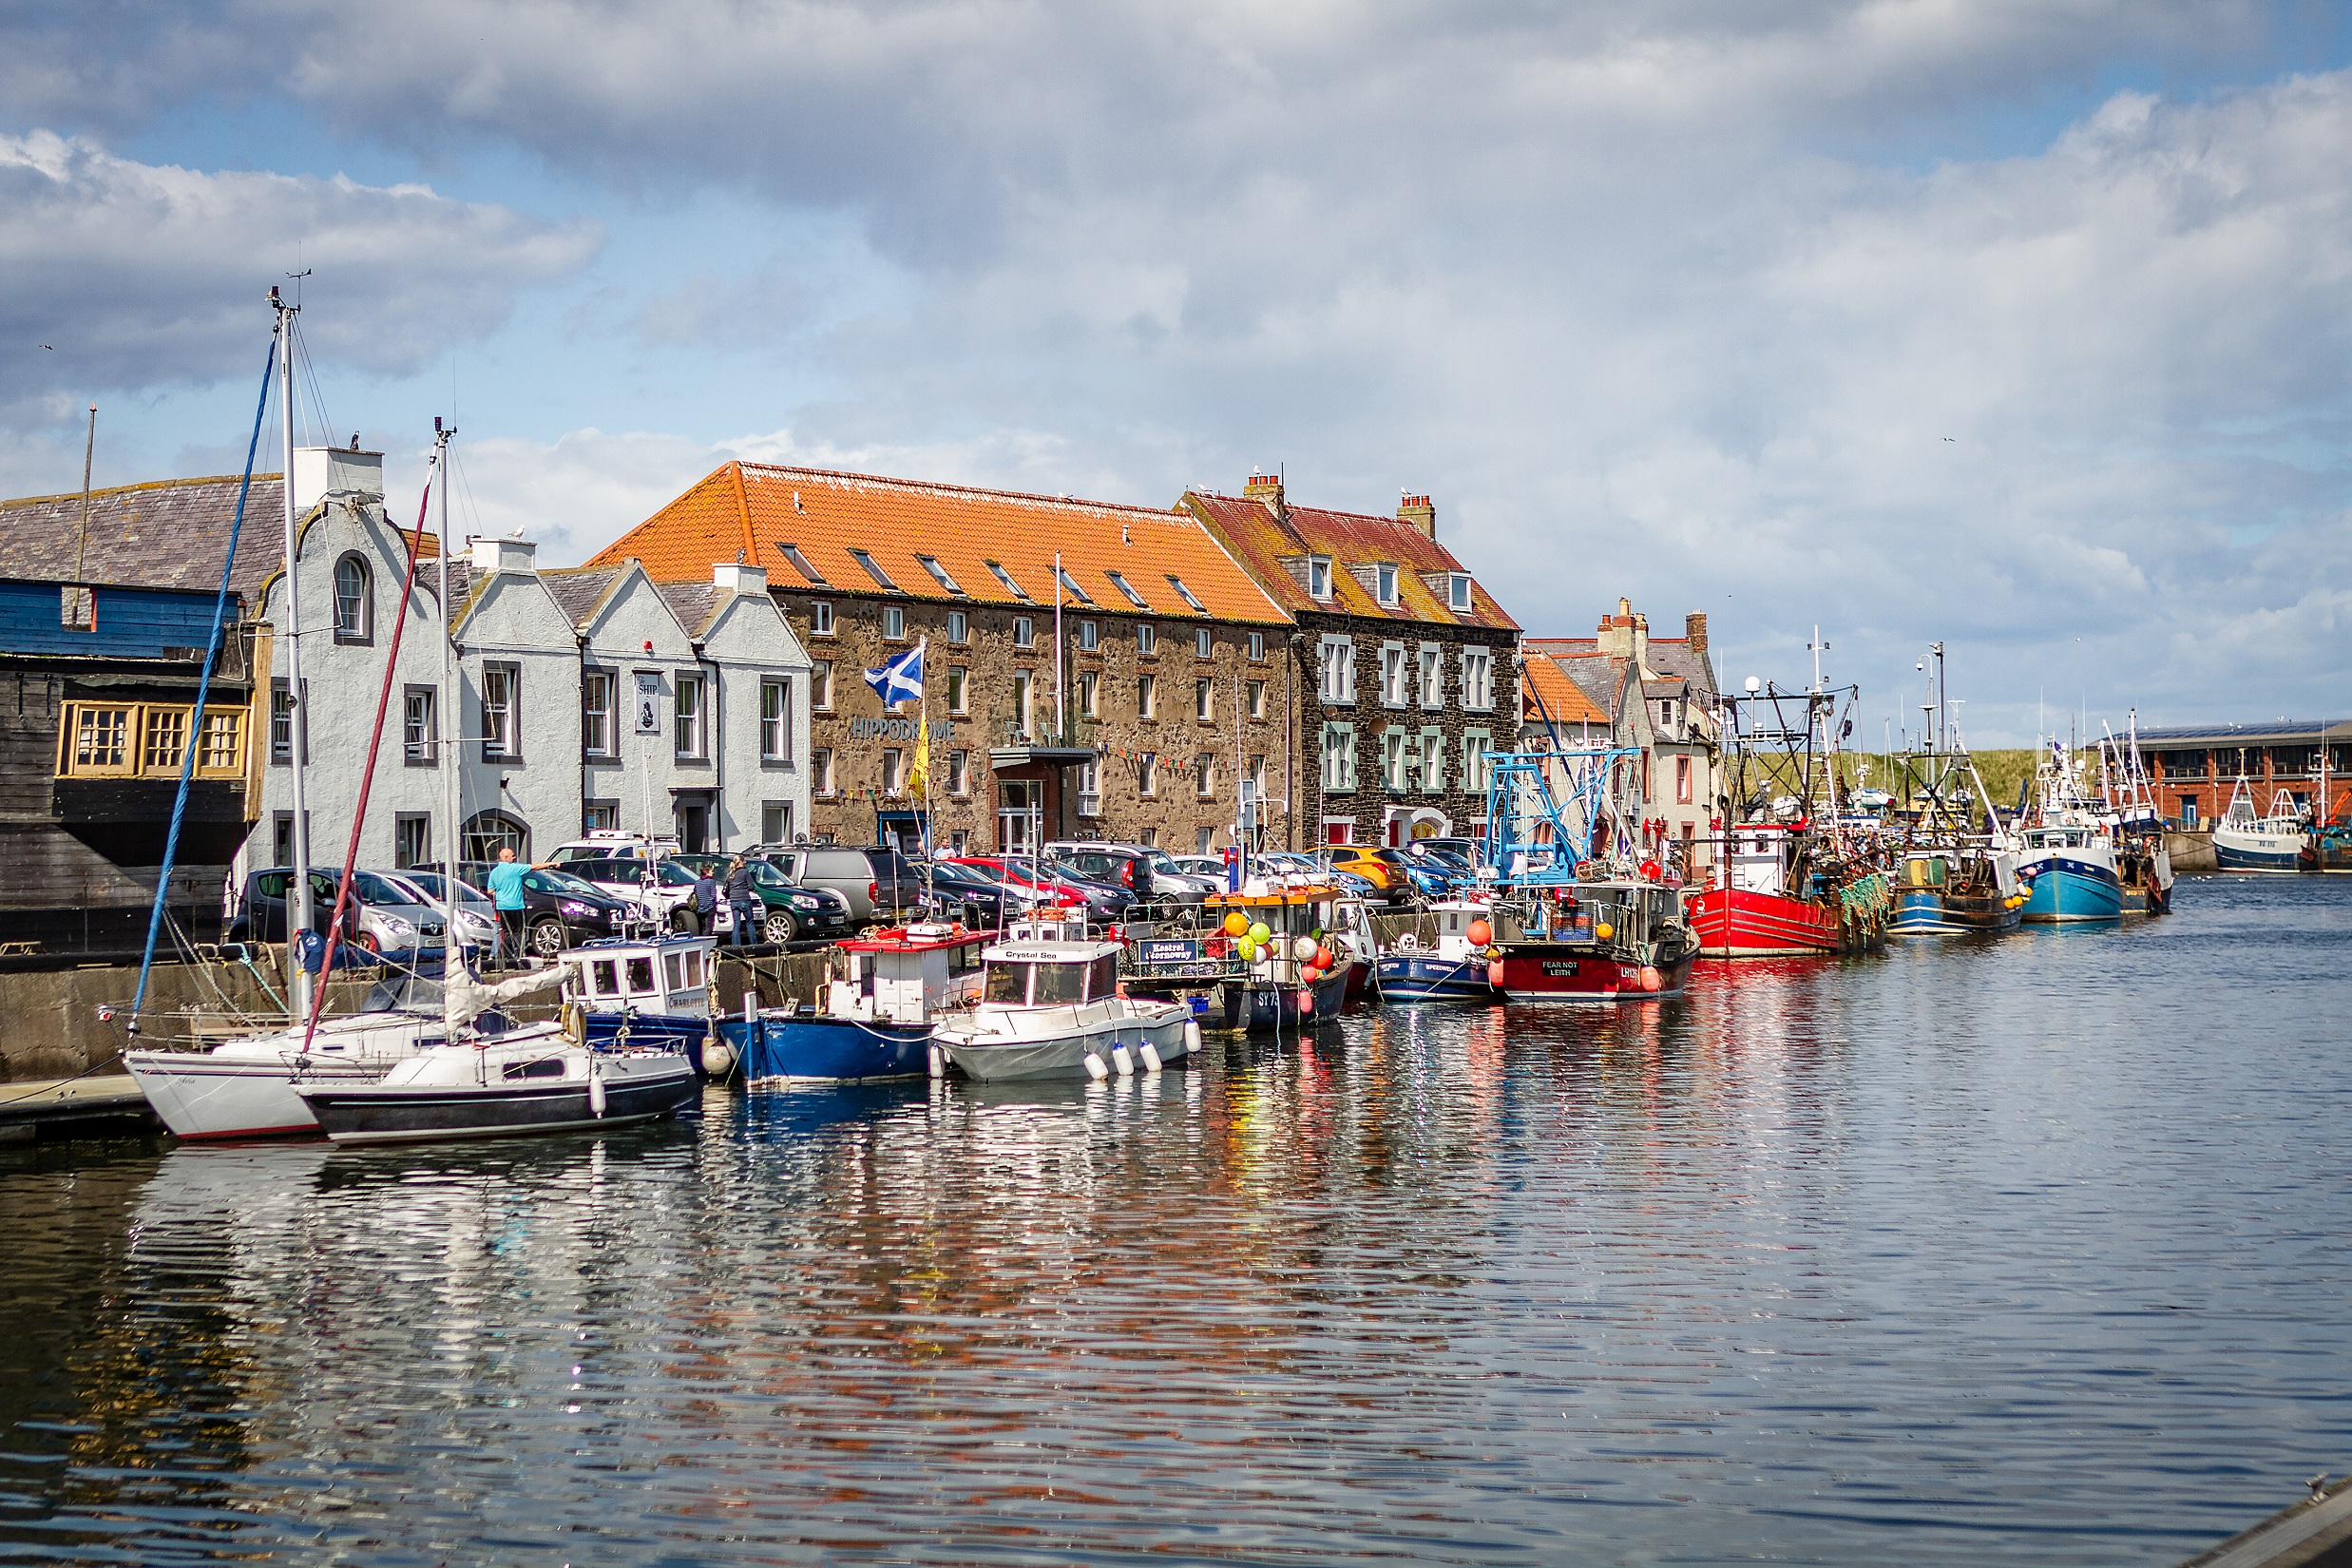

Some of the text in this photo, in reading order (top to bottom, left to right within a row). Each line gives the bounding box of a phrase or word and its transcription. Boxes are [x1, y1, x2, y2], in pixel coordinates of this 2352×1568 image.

[639, 684, 658, 695] SHIP
[852, 717, 955, 741] HIPPODROME
[1153, 942, 1185, 952] Kestrel
[1425, 964, 1456, 973] SPEEDWELL
[669, 996, 705, 1009] CHARLOTTE
[1258, 991, 1269, 1007] SY
